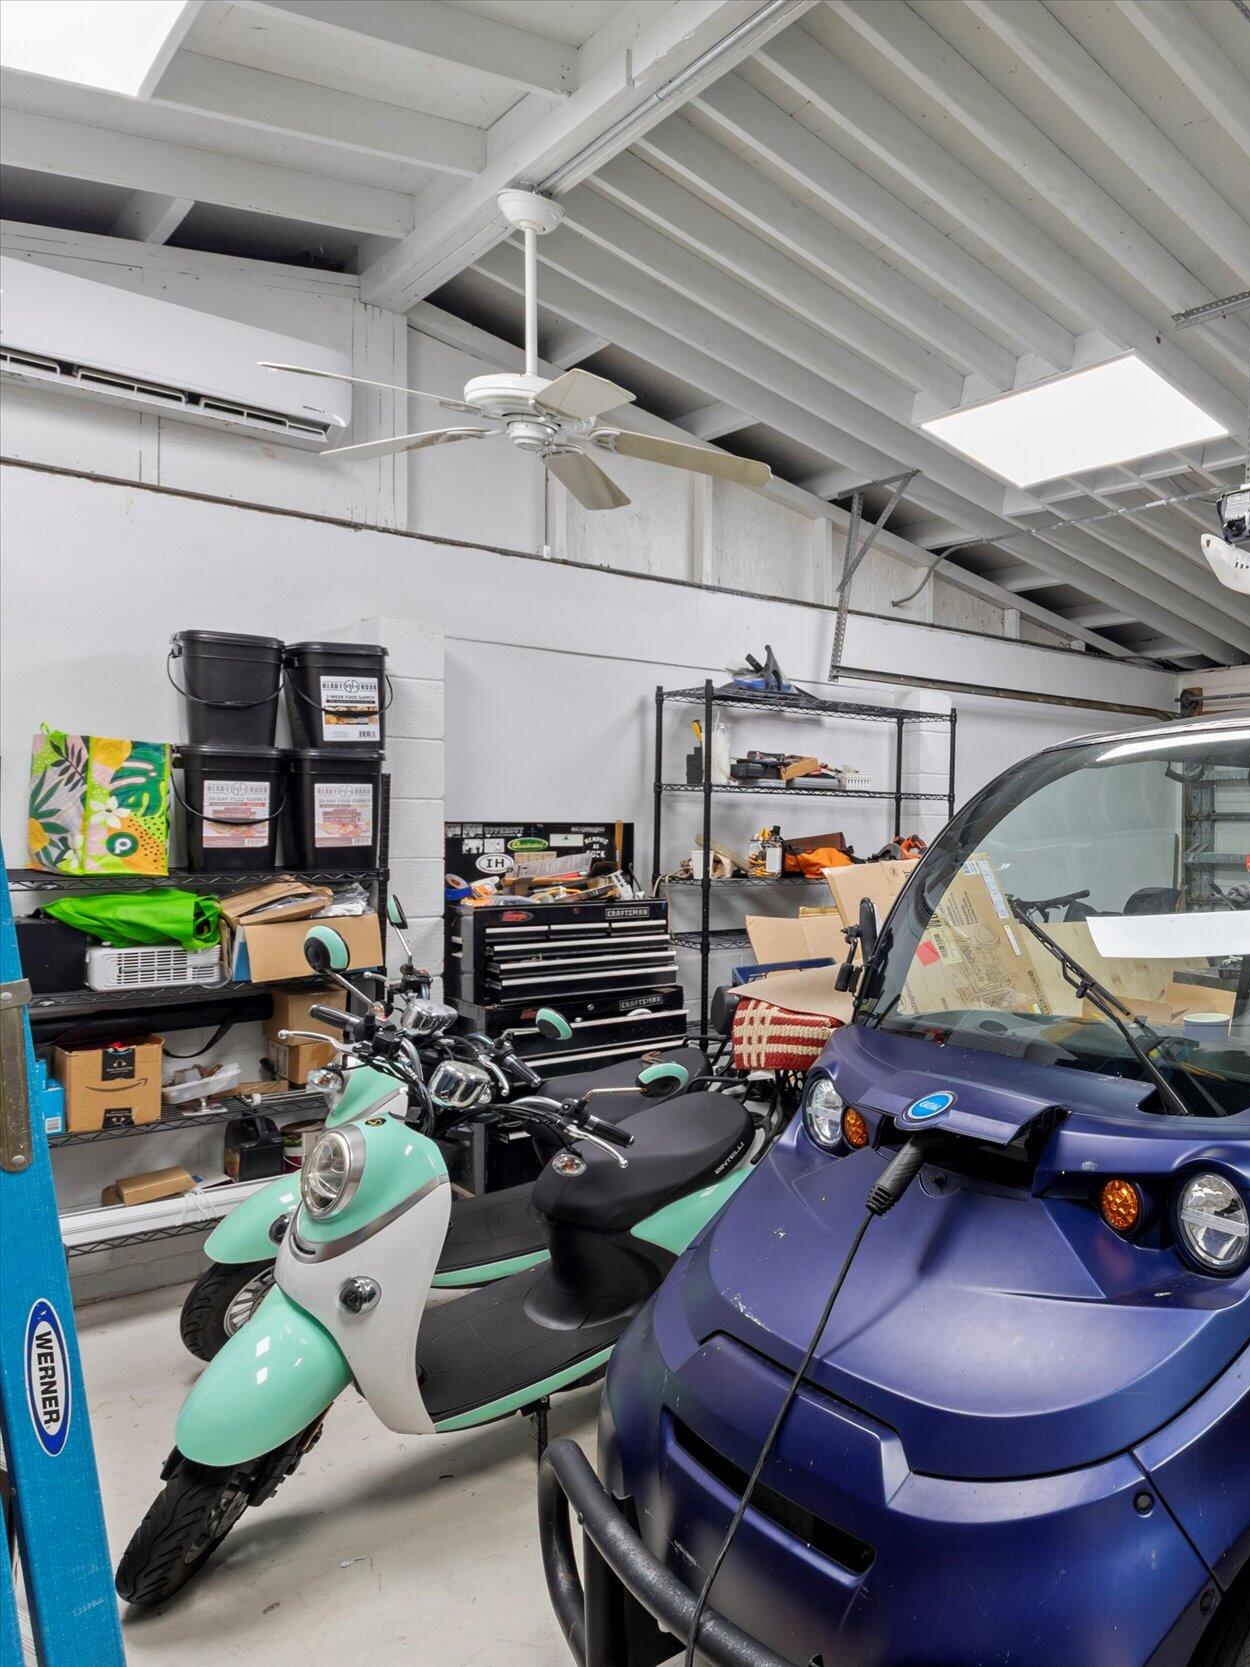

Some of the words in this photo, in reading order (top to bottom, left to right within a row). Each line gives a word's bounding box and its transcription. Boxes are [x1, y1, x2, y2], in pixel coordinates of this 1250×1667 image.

[486, 858, 504, 868] IH
[607, 908, 648, 917] CRAFTSMAN
[621, 996, 662, 1009] CRAFTSMAN
[35, 1330, 61, 1426] WERNER
